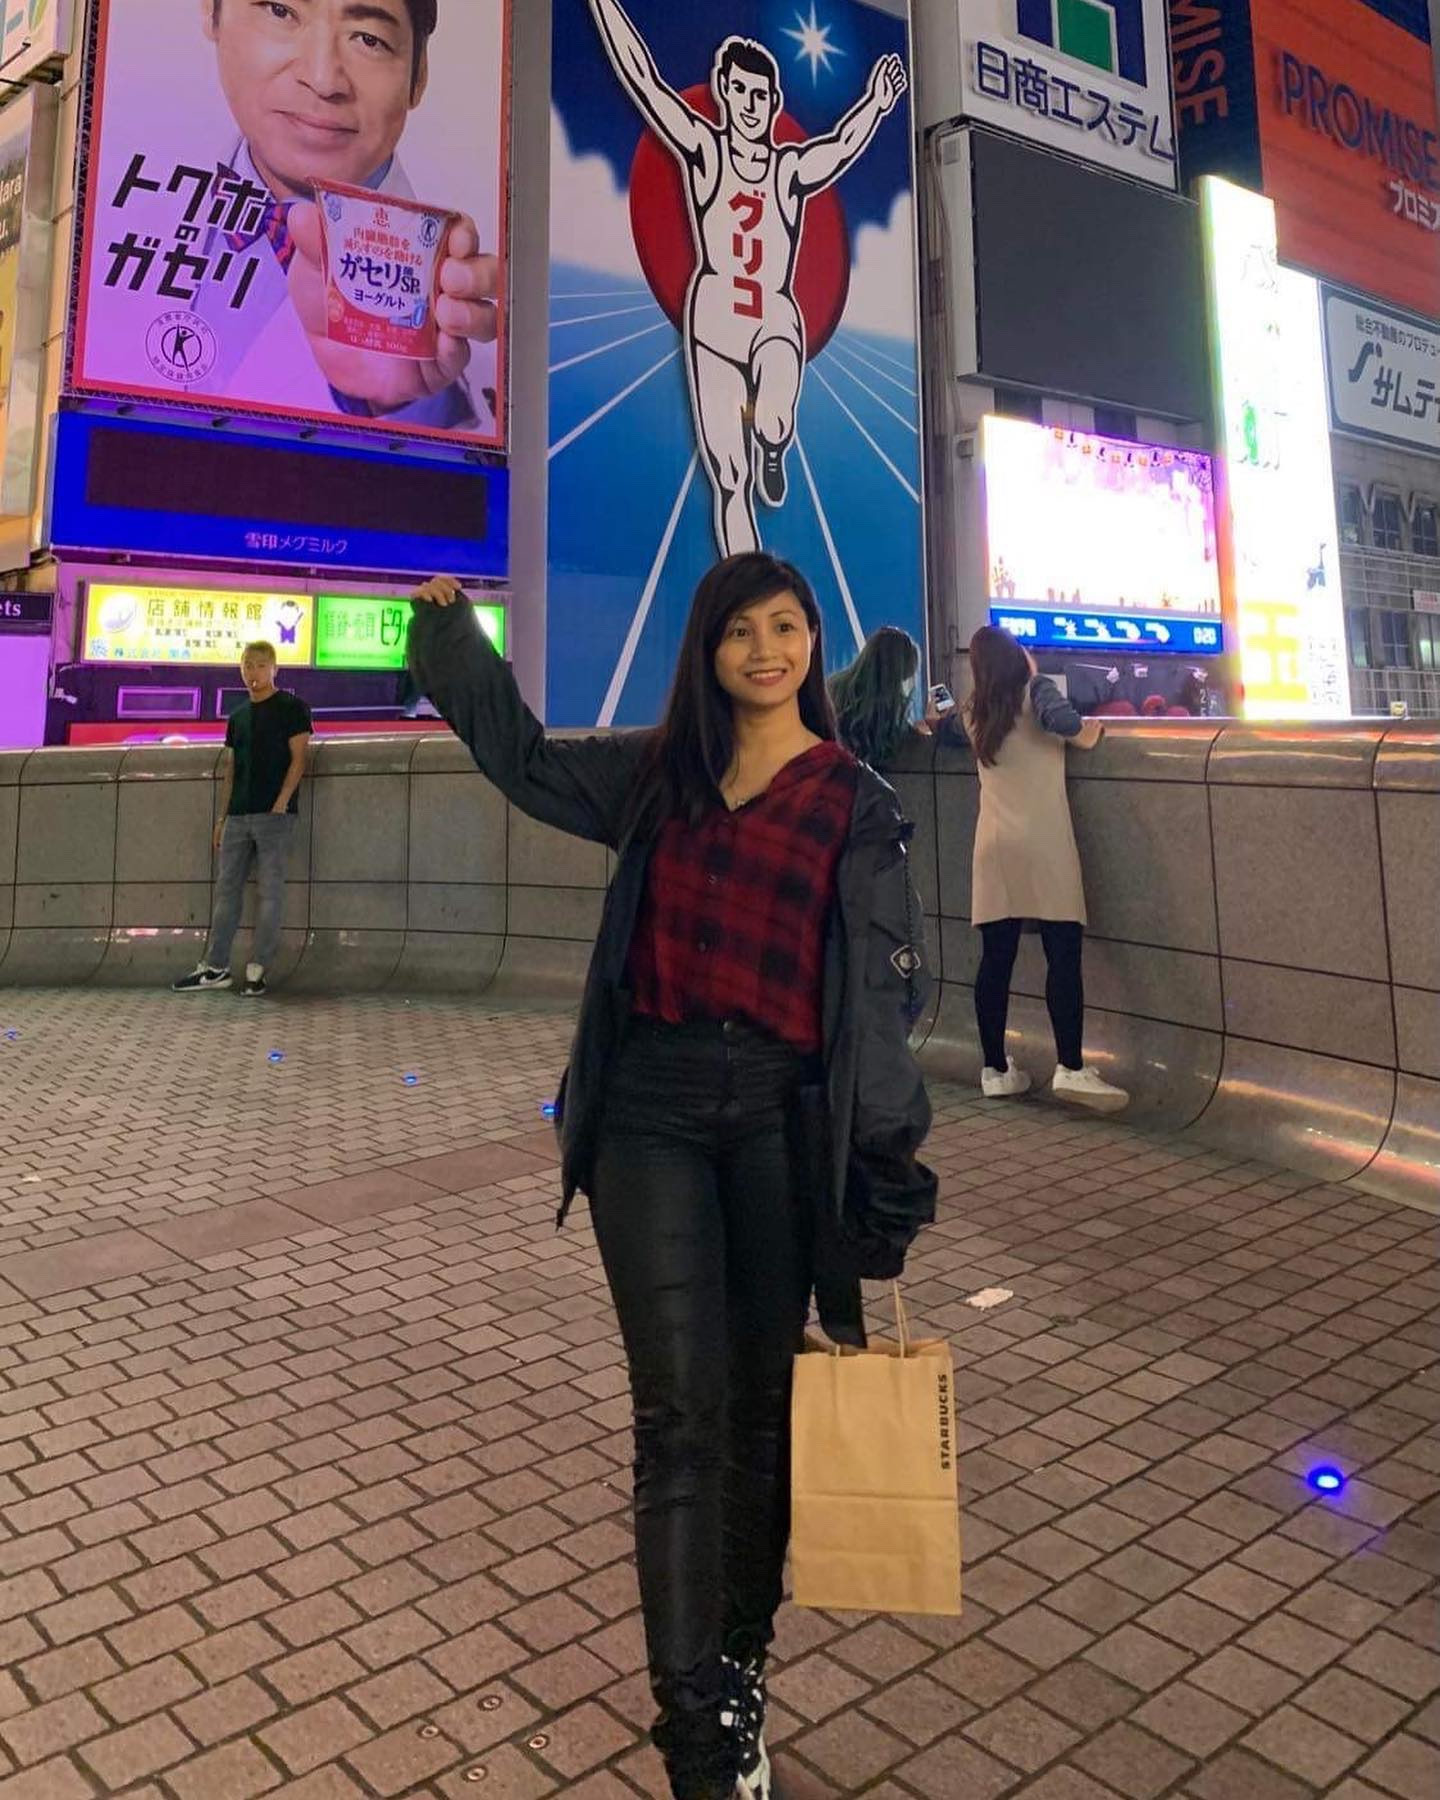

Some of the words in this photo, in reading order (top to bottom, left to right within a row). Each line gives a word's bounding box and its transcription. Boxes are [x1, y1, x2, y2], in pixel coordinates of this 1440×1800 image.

[1280, 50, 1440, 193] PROMISE
[111, 153, 266, 233] トクホ
[174, 224, 200, 242] の
[728, 190, 766, 319] グリコ
[104, 233, 260, 309] ガセリ
[354, 289, 405, 310] ヨーグルト
[1371, 365, 1440, 423] サムテ
[0, 600, 21, 617] ts
[381, 607, 406, 646] ピタ
[937, 1374, 951, 1470] STARBUCKS
